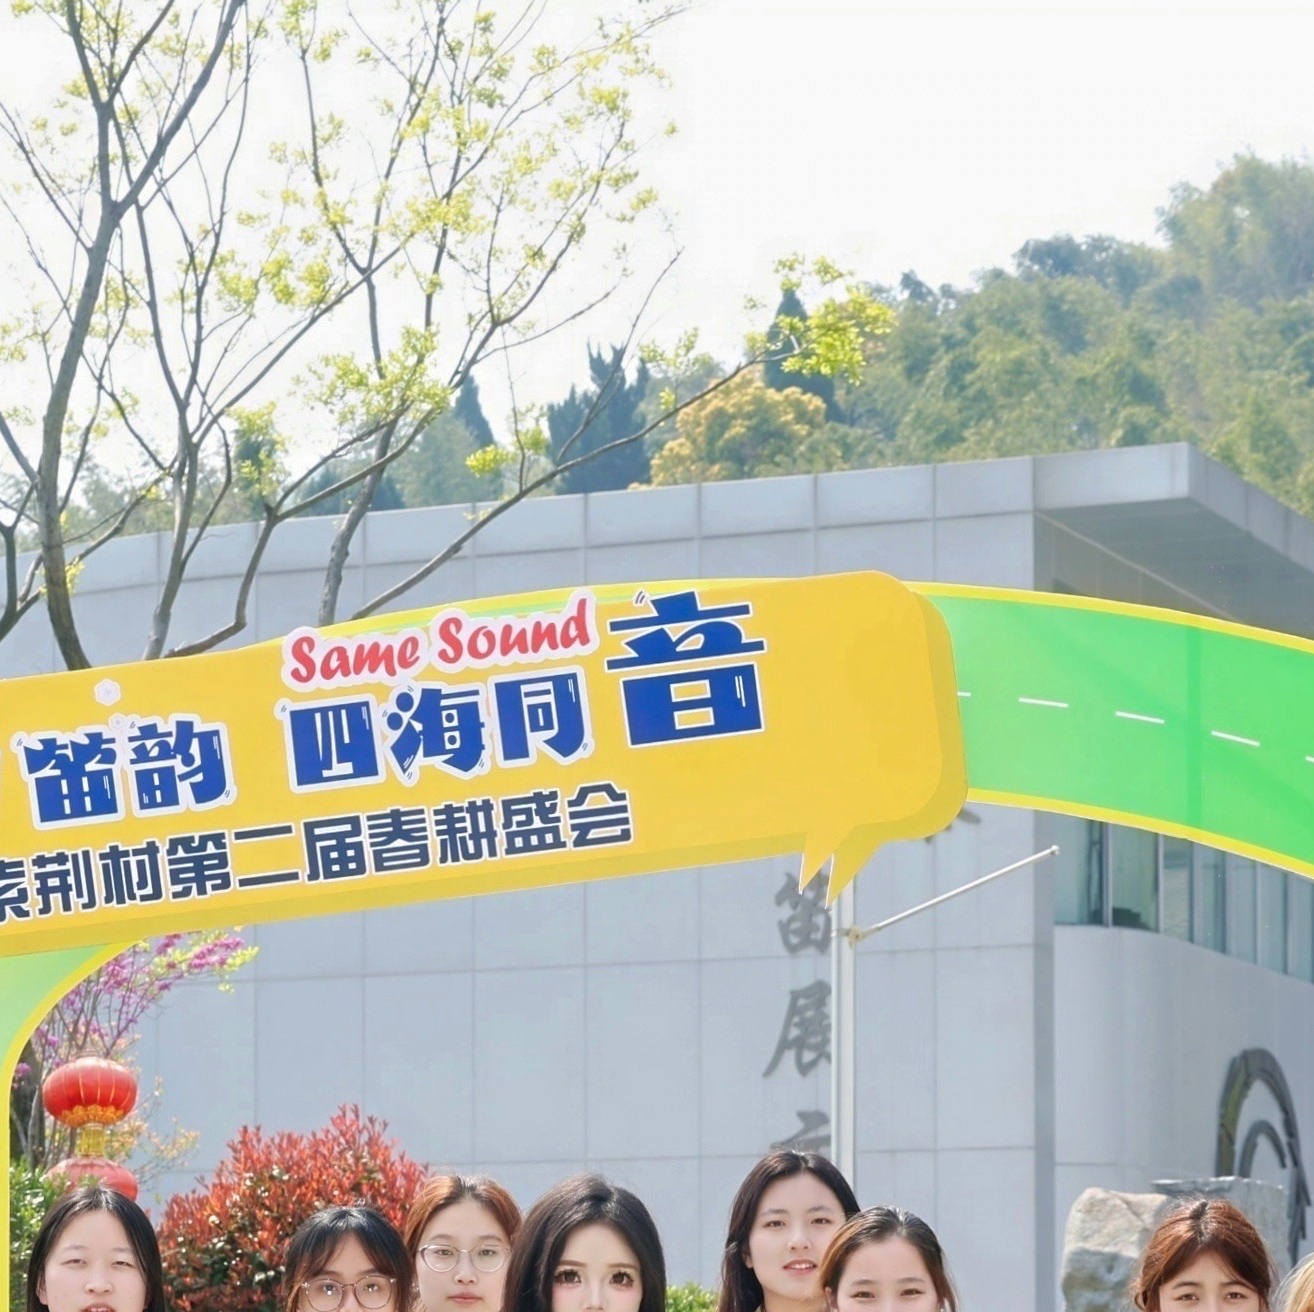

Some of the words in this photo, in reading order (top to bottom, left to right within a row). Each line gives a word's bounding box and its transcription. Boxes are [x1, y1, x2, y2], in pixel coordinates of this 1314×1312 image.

[289, 590, 766, 786] 四海同音
[290, 635, 420, 684] Same
[438, 598, 591, 664] Sound
